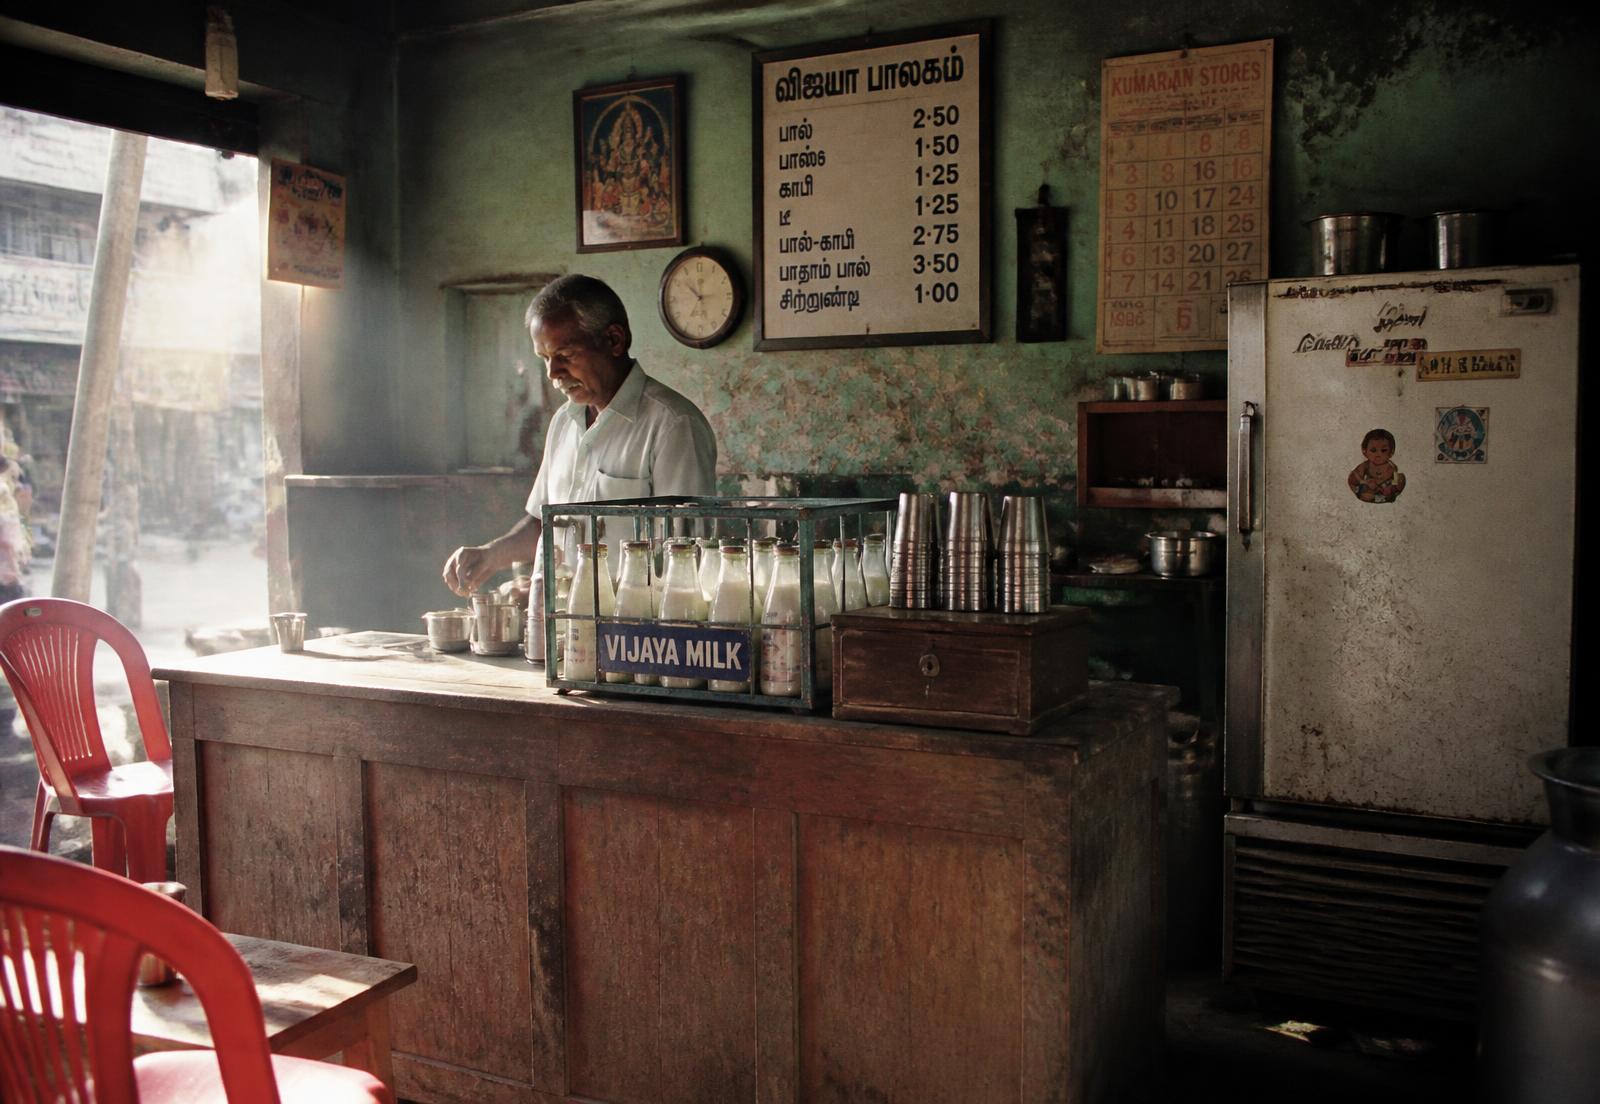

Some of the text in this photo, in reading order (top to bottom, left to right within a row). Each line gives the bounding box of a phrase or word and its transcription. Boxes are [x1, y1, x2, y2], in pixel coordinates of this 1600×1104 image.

[776, 45, 964, 103] விஜயா பாலகம்
[1200, 61, 1261, 87] STORES
[779, 117, 813, 142] பால்
[1193, 160, 1216, 181] 16
[779, 174, 813, 198] காபி
[1154, 190, 1178, 211] 10
[1192, 187, 1217, 209] 17
[1228, 185, 1255, 206] 24
[1122, 213, 1254, 240] 4 11 18 25
[779, 228, 855, 253] பால்-காபி
[1121, 242, 1253, 265] 6 13 20 27
[779, 257, 831, 285] பாதாம்
[837, 255, 871, 278] பால்
[1121, 274, 1135, 293] 7
[1151, 272, 1175, 292] 14
[1188, 270, 1212, 291] 21
[605, 634, 680, 666] VIJAYA
[686, 639, 742, 670] MILK
